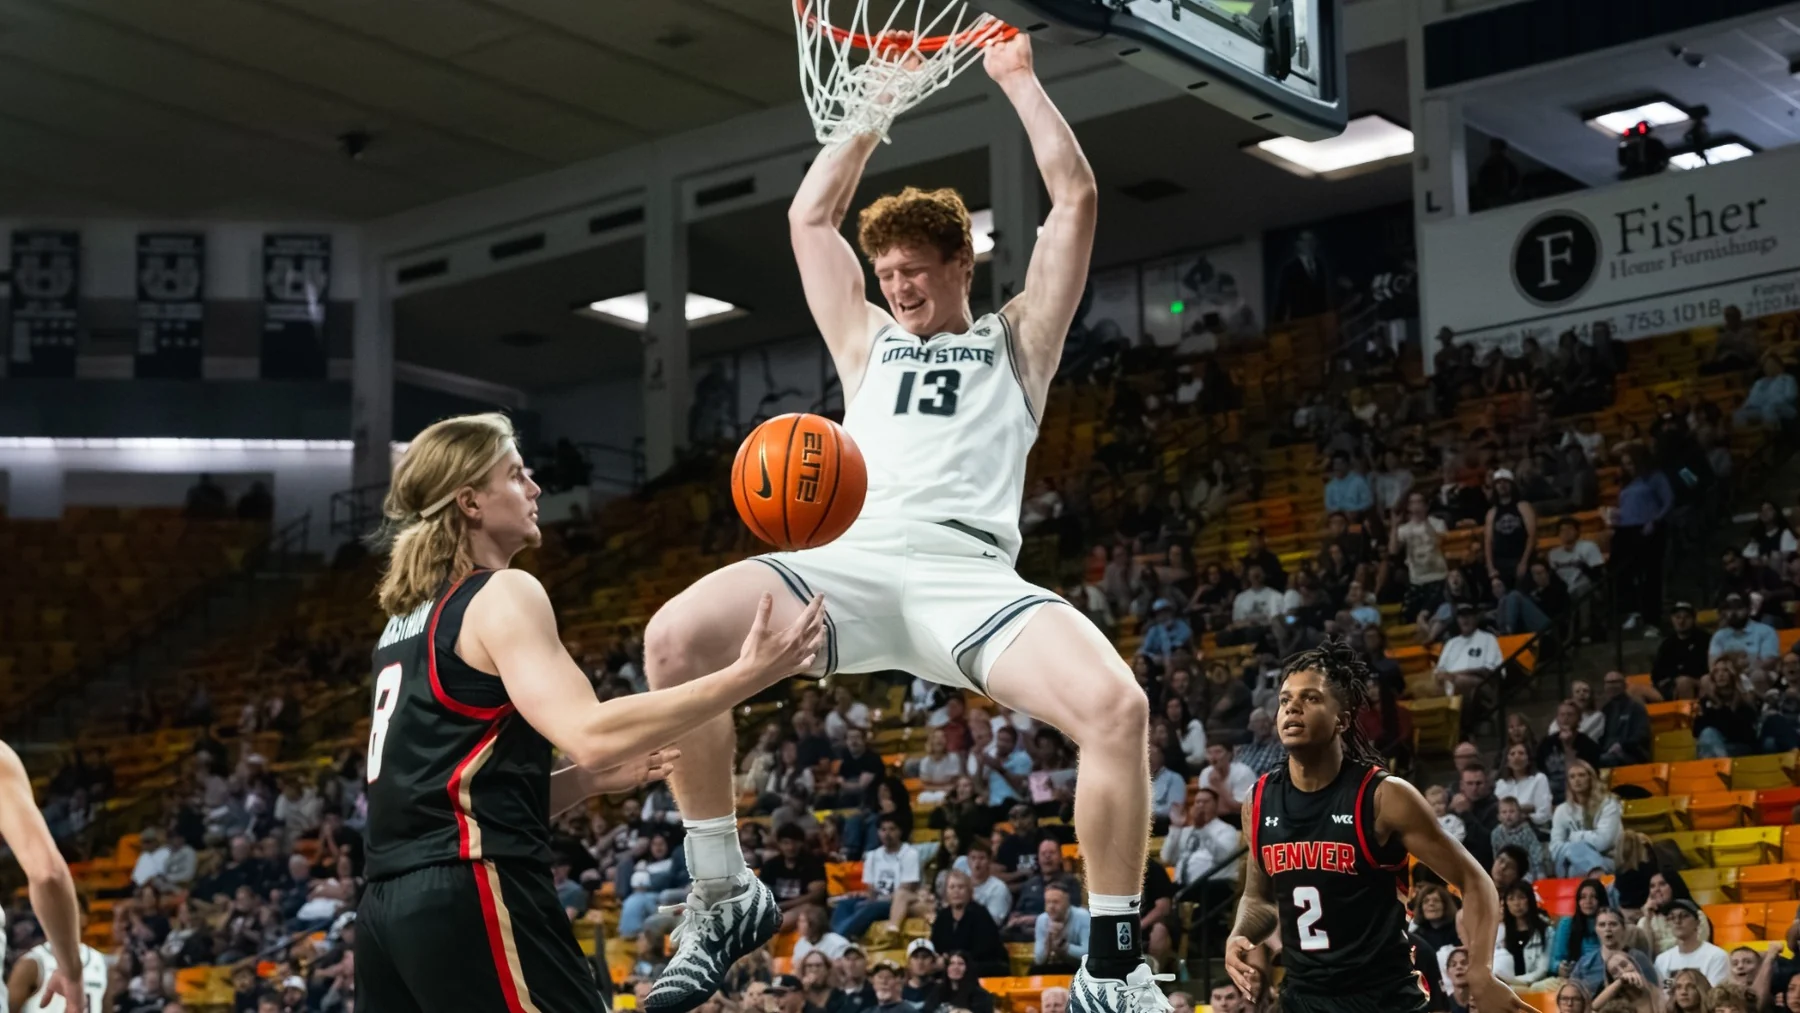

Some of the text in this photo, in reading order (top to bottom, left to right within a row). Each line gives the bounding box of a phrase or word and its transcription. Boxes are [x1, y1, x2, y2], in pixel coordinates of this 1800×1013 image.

[1426, 191, 1442, 213] L
[1613, 193, 1767, 256] Fisher
[1536, 230, 1574, 288] F
[1610, 235, 1778, 279] Home Furnishings
[881, 346, 995, 366] UTAH STATE
[893, 368, 962, 417] 13
[795, 431, 823, 504] ELITE
[366, 661, 403, 785] 8
[1261, 840, 1359, 877] DENVER
[1292, 886, 1330, 951] 2
